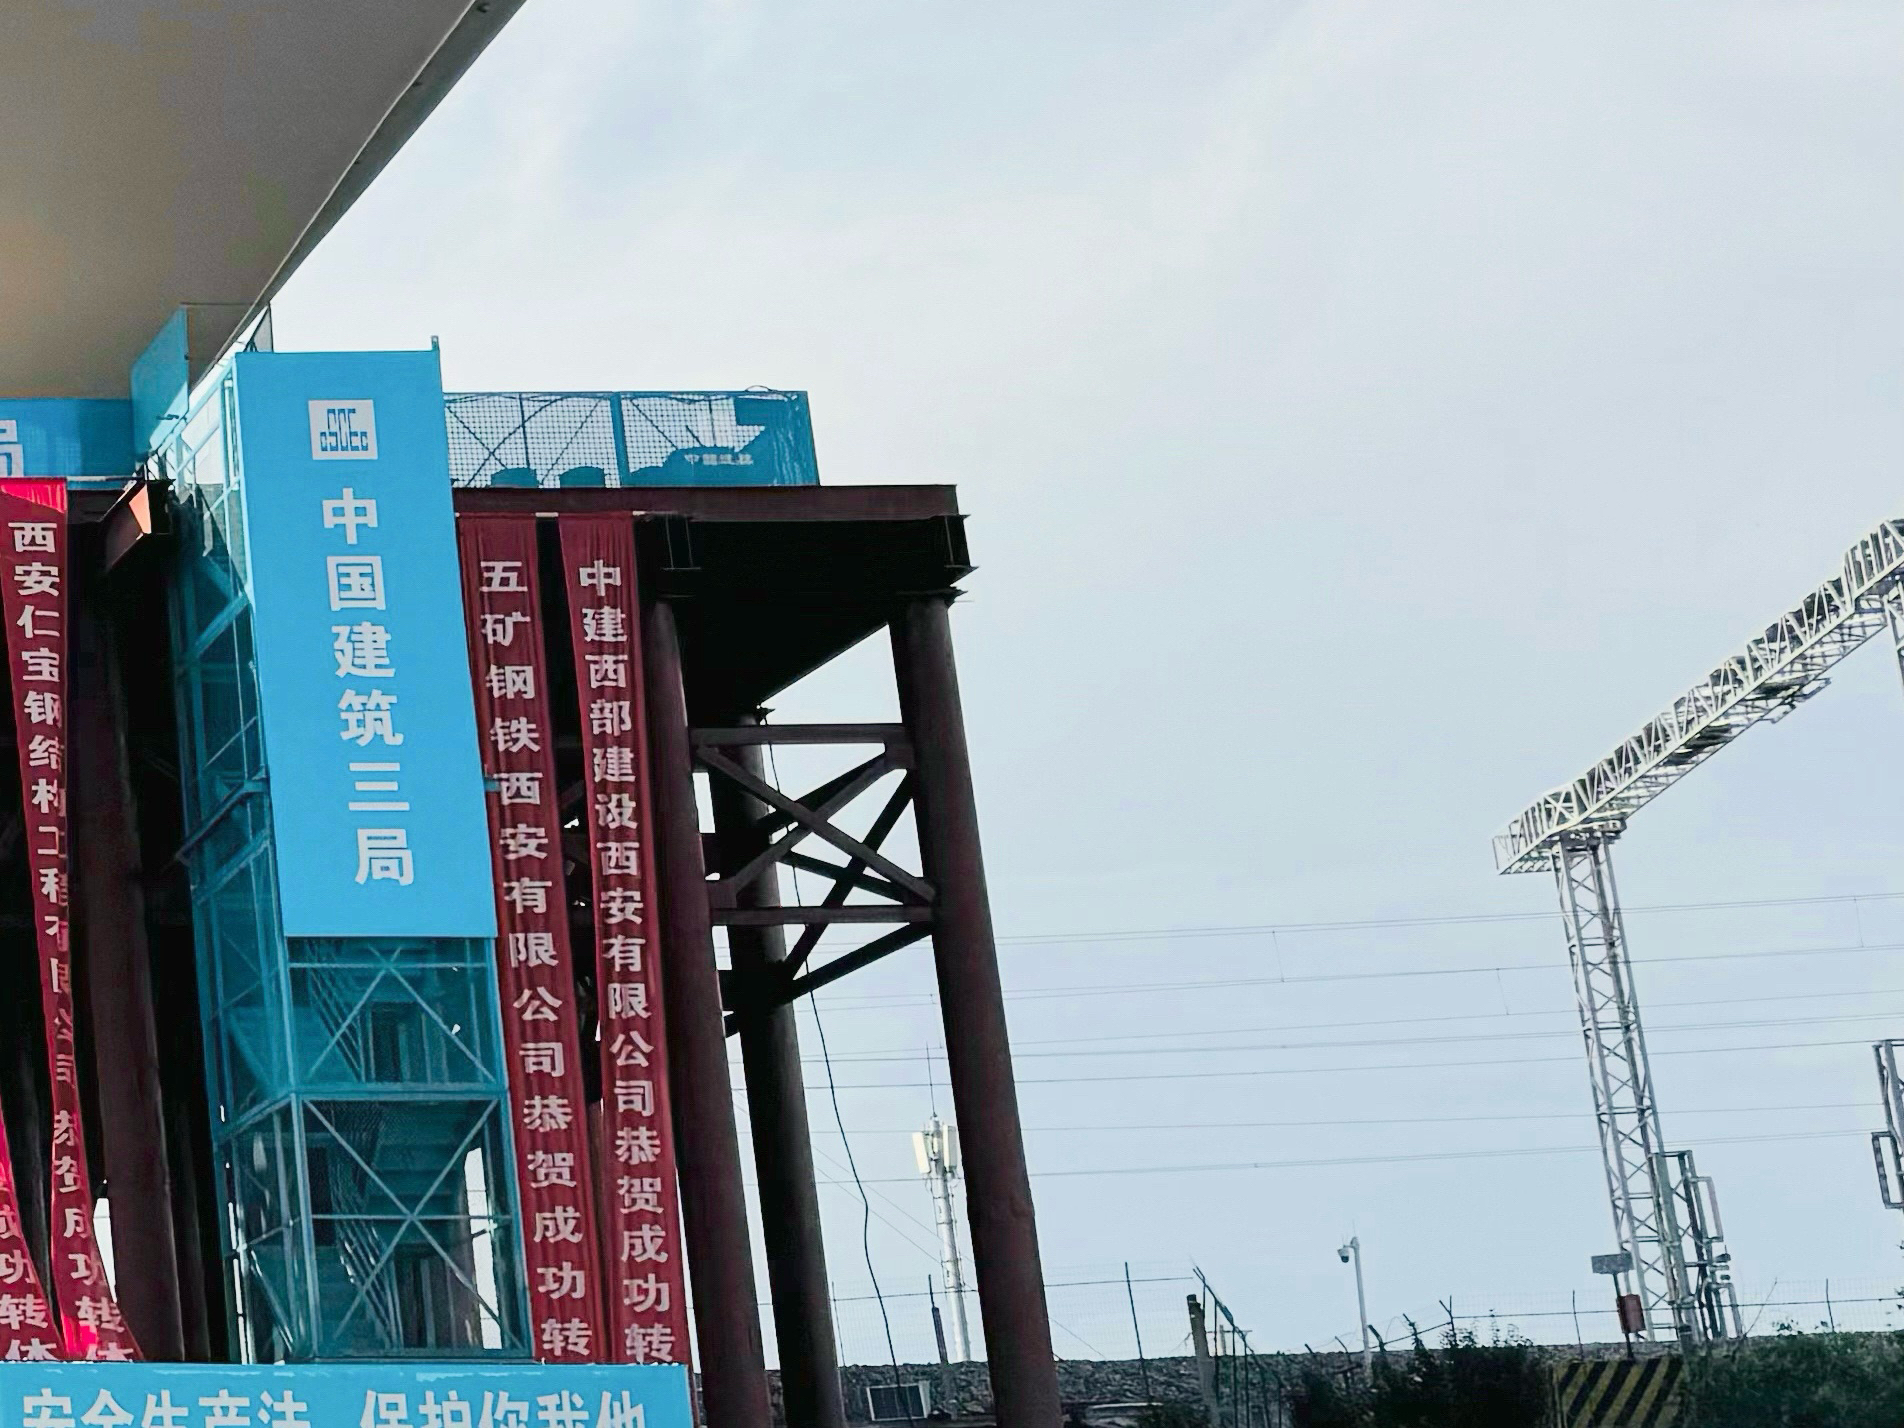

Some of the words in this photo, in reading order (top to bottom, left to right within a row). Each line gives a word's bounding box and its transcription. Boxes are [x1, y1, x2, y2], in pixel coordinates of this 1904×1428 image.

[321, 487, 416, 887] 中国建筑三局
